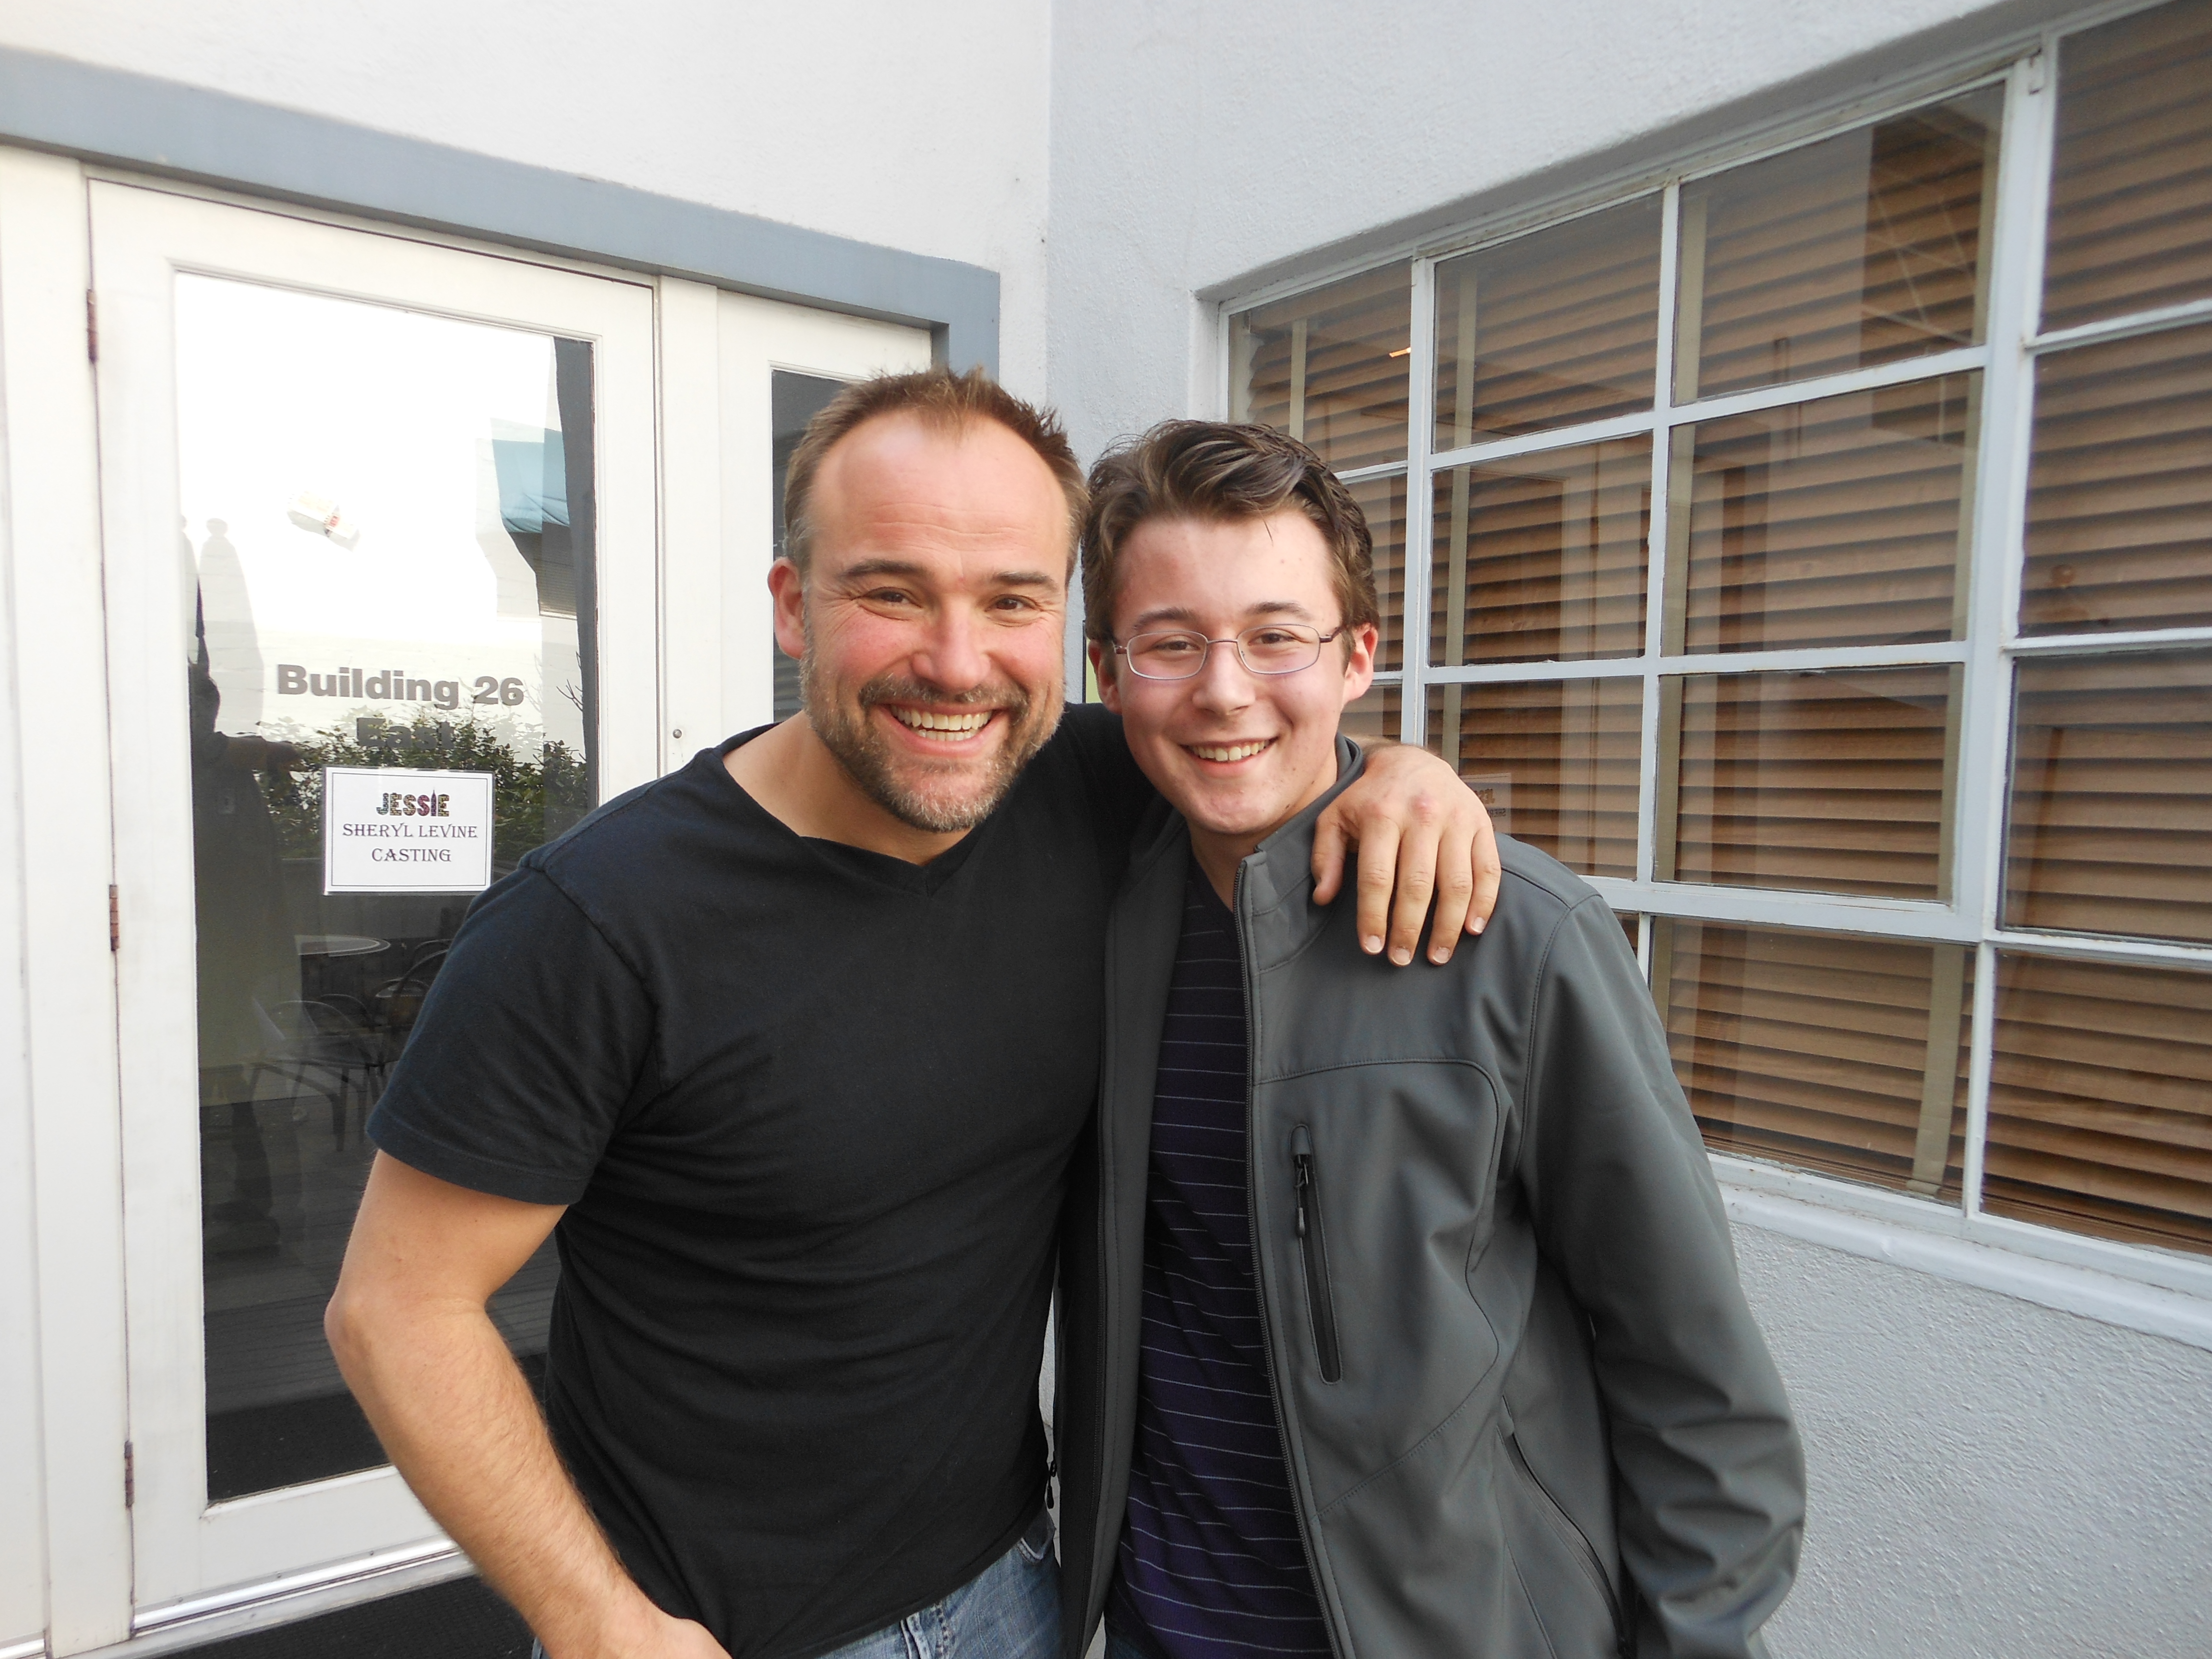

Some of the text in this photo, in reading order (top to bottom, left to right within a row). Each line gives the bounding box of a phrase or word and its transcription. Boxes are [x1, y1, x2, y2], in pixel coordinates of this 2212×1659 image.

[277, 663, 524, 710] Building 26
[356, 717, 455, 750] East
[376, 788, 450, 817] JESSIE
[342, 823, 479, 838] SHERYL LEVINE
[372, 848, 452, 862] CASTING
